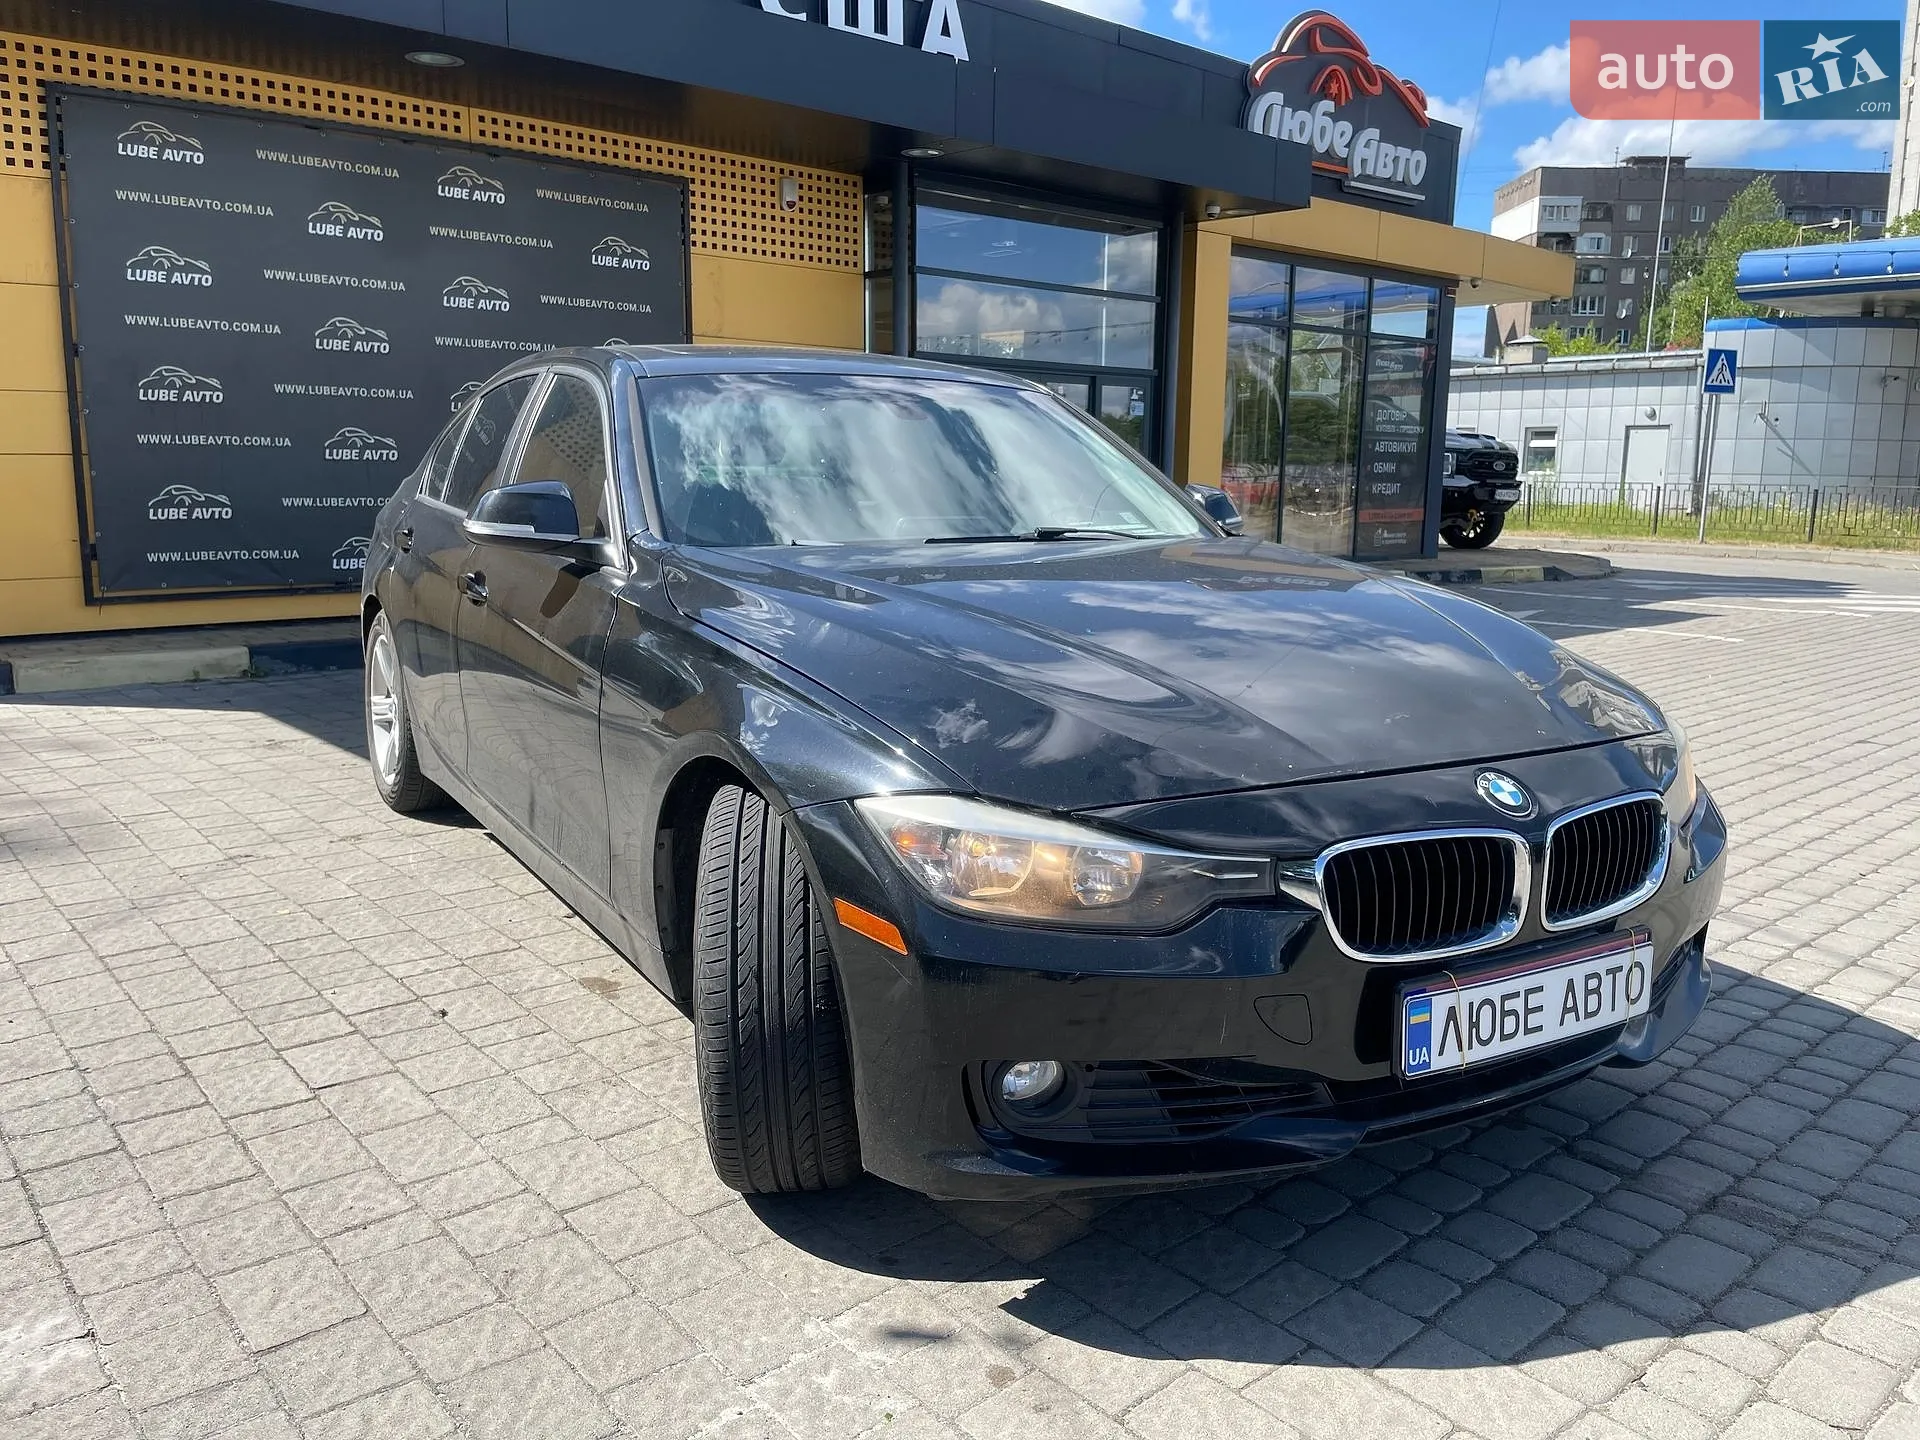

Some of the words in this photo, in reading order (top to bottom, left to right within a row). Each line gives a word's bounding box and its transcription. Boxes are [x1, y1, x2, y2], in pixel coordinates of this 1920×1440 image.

[1248, 91, 1353, 159] Любе
[118, 142, 158, 160] LUBE
[162, 149, 205, 165] AVTO
[256, 148, 400, 179] WWW.LUBEAVTO.COM.UA
[115, 189, 274, 217] WWW.LUBEAVTO.COM.UA
[437, 184, 470, 201] LUBE
[473, 189, 506, 205] AVTO
[536, 188, 649, 213] WWW.LUBEAVTO.COM.UA
[308, 221, 344, 238] LUBE
[347, 225, 384, 242] AVTO
[429, 226, 554, 249] WWW.LUBEAVTO.COM.UA
[591, 254, 619, 268] LUBE
[621, 257, 650, 271] AVTO
[126, 268, 167, 284] LUBE
[170, 271, 213, 287] AVTO
[263, 268, 406, 292] WWW.LUBEAVTO.COM.UA
[443, 295, 475, 310] LUBE
[477, 298, 510, 312] AVTO
[540, 295, 652, 313] WWW.LUBEAVTO.COM.UA
[124, 314, 282, 335] WWW.LUBEAVTO.COM.UA
[315, 338, 350, 352] LUBE
[353, 340, 390, 355] AVTO
[138, 388, 179, 402] LUBE
[182, 390, 224, 404] AVTO
[274, 383, 414, 400] WWW.LUBEAVTO.COM.UA
[137, 433, 292, 448] WWW.LUBEAVTO.COM.UA
[1374, 441, 1417, 453] АВТОВИКУП
[325, 448, 360, 461] LUBE
[363, 448, 399, 461] AVTO
[1373, 462, 1396, 473] ОБМІН
[1371, 483, 1401, 495] КРЕДИТ
[149, 507, 188, 520] LUBE
[192, 506, 233, 520] AVTO
[147, 549, 300, 563] WWW.LUBEAVTO.COM.UA
[1437, 985, 1545, 1057] ЛЮБЕ
[1558, 960, 1646, 1027] АВТО
[1408, 1046, 1430, 1066] UA
